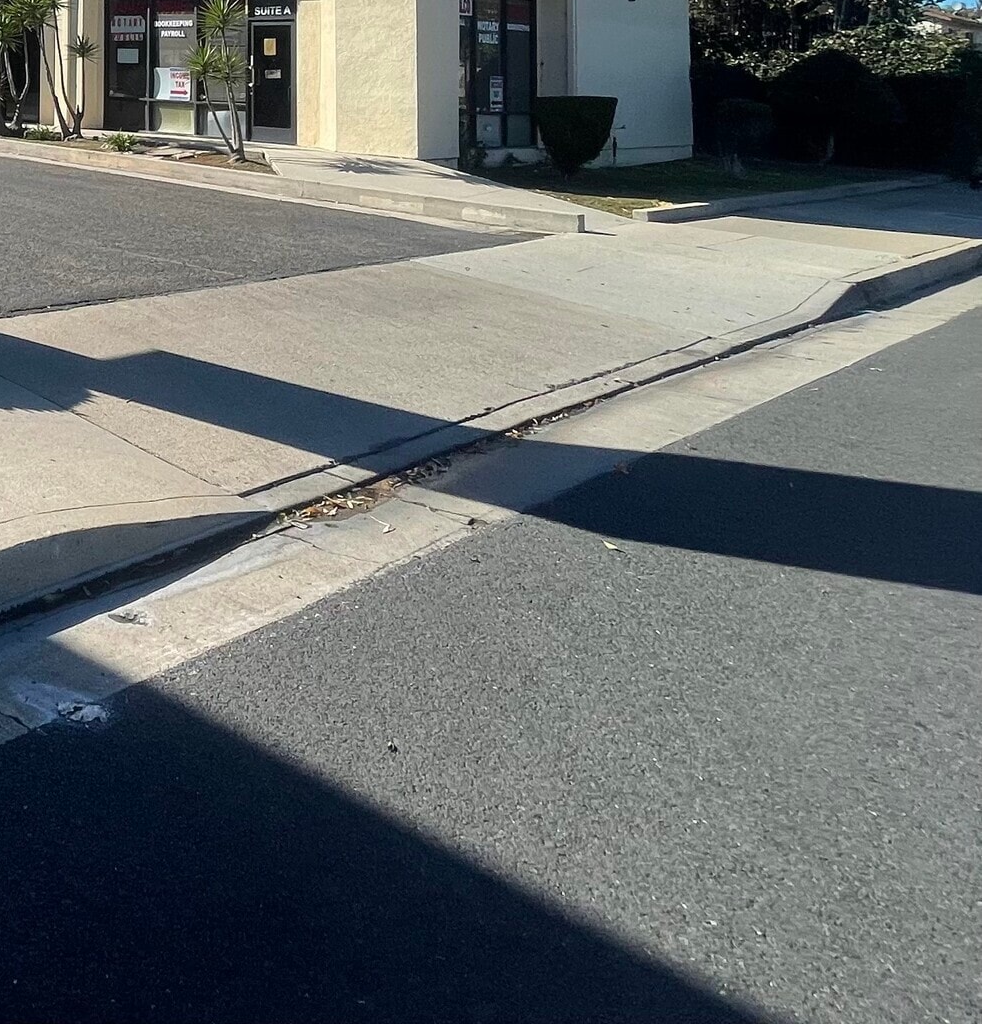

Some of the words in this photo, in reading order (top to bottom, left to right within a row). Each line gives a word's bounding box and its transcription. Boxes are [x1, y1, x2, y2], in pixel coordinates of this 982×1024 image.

[254, 6, 282, 16] SUITE
[283, 6, 291, 15] A
[161, 30, 186, 38] PAYROLL
[175, 80, 185, 88] TAX
